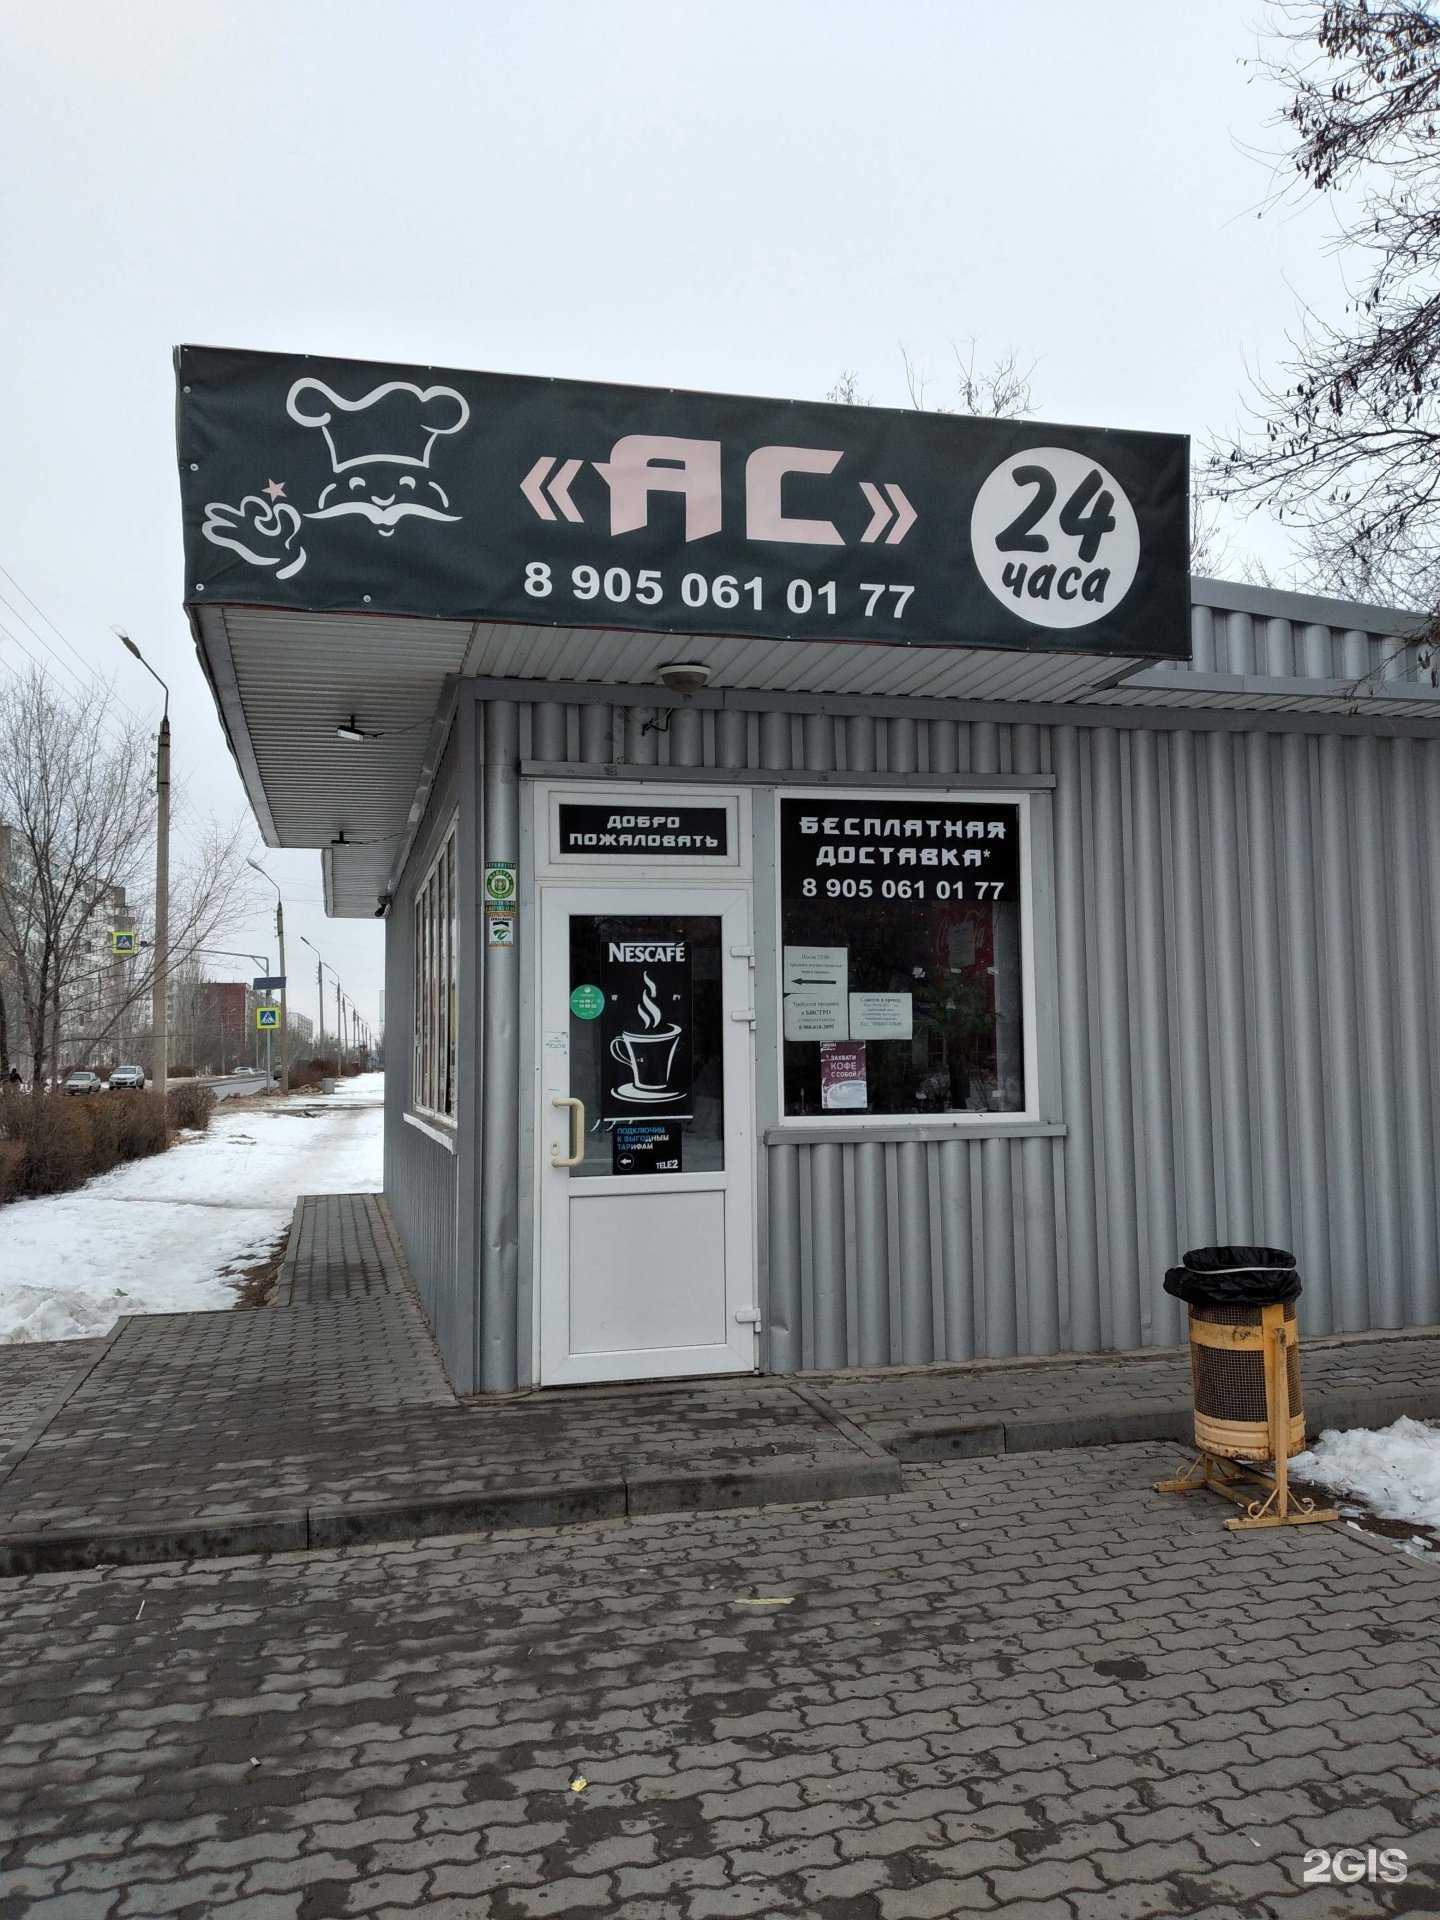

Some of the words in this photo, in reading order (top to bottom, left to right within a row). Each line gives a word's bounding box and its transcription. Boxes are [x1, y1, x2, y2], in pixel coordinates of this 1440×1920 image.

[995, 465, 1116, 563] 24
[524, 561, 553, 598] 8
[571, 565, 663, 605] 905
[681, 572, 763, 611] 061
[786, 578, 837, 615] 01
[859, 582, 915, 619] 77
[1001, 562, 1111, 603] часа
[607, 815, 680, 829] ДОБРО
[799, 816, 1007, 839] БЕСПЛАТНАЯ
[569, 833, 718, 848] ПОЖАЛОВАТЬ
[802, 878, 817, 897] 8
[825, 878, 873, 898] 905
[881, 879, 925, 899] 061
[936, 880, 963, 899] 01
[974, 881, 1005, 900] 77
[608, 942, 685, 962] NESCAFÉ
[830, 1062, 857, 1070] КОФЕ
[656, 1160, 679, 1169] TELE2
